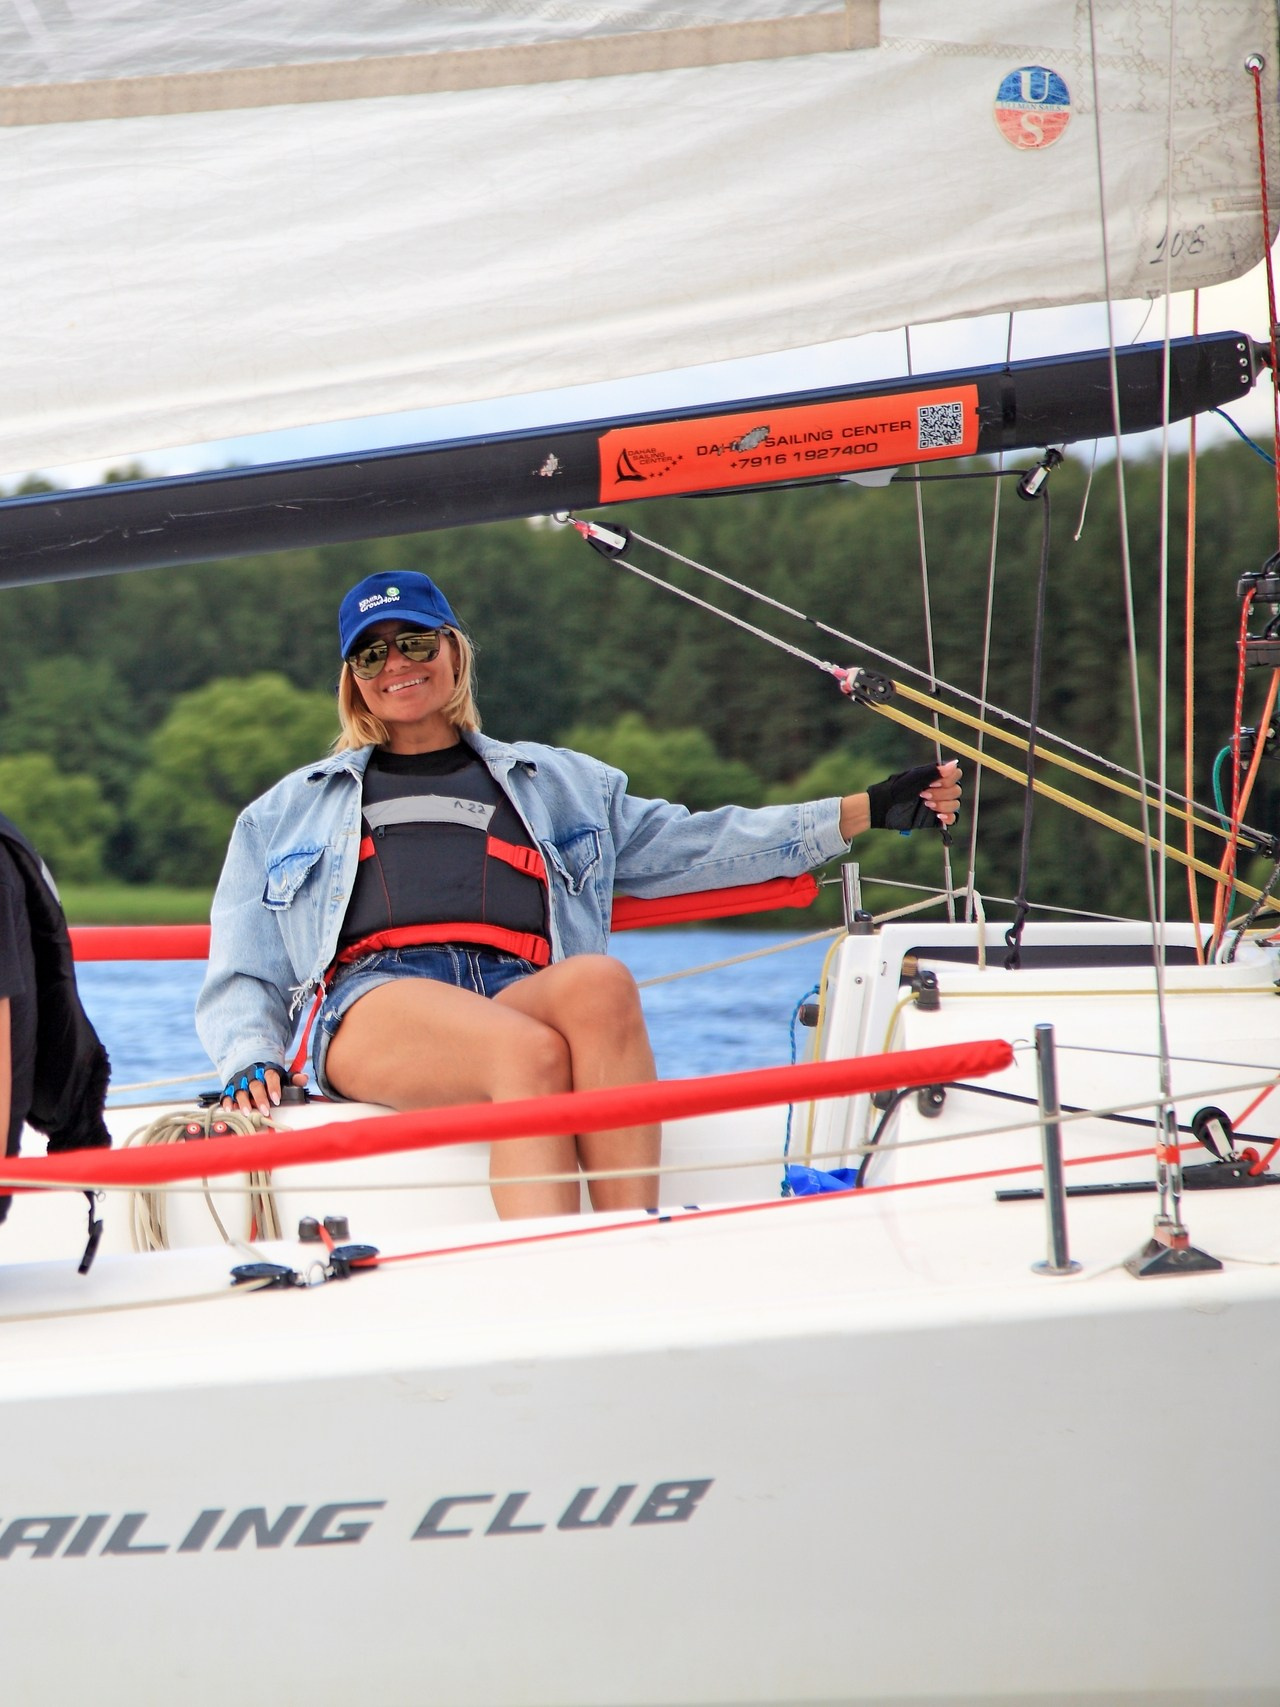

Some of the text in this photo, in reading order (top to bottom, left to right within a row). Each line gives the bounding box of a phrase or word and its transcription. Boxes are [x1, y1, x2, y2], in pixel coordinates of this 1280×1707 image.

[1018, 70, 1053, 103] U
[1017, 112, 1044, 145] S
[1150, 223, 1205, 264] 108
[765, 430, 833, 448] SAILING
[842, 420, 912, 439] CENTER
[731, 442, 879, 470] +7916 1927400
[410, 1478, 715, 1542] CLUB
